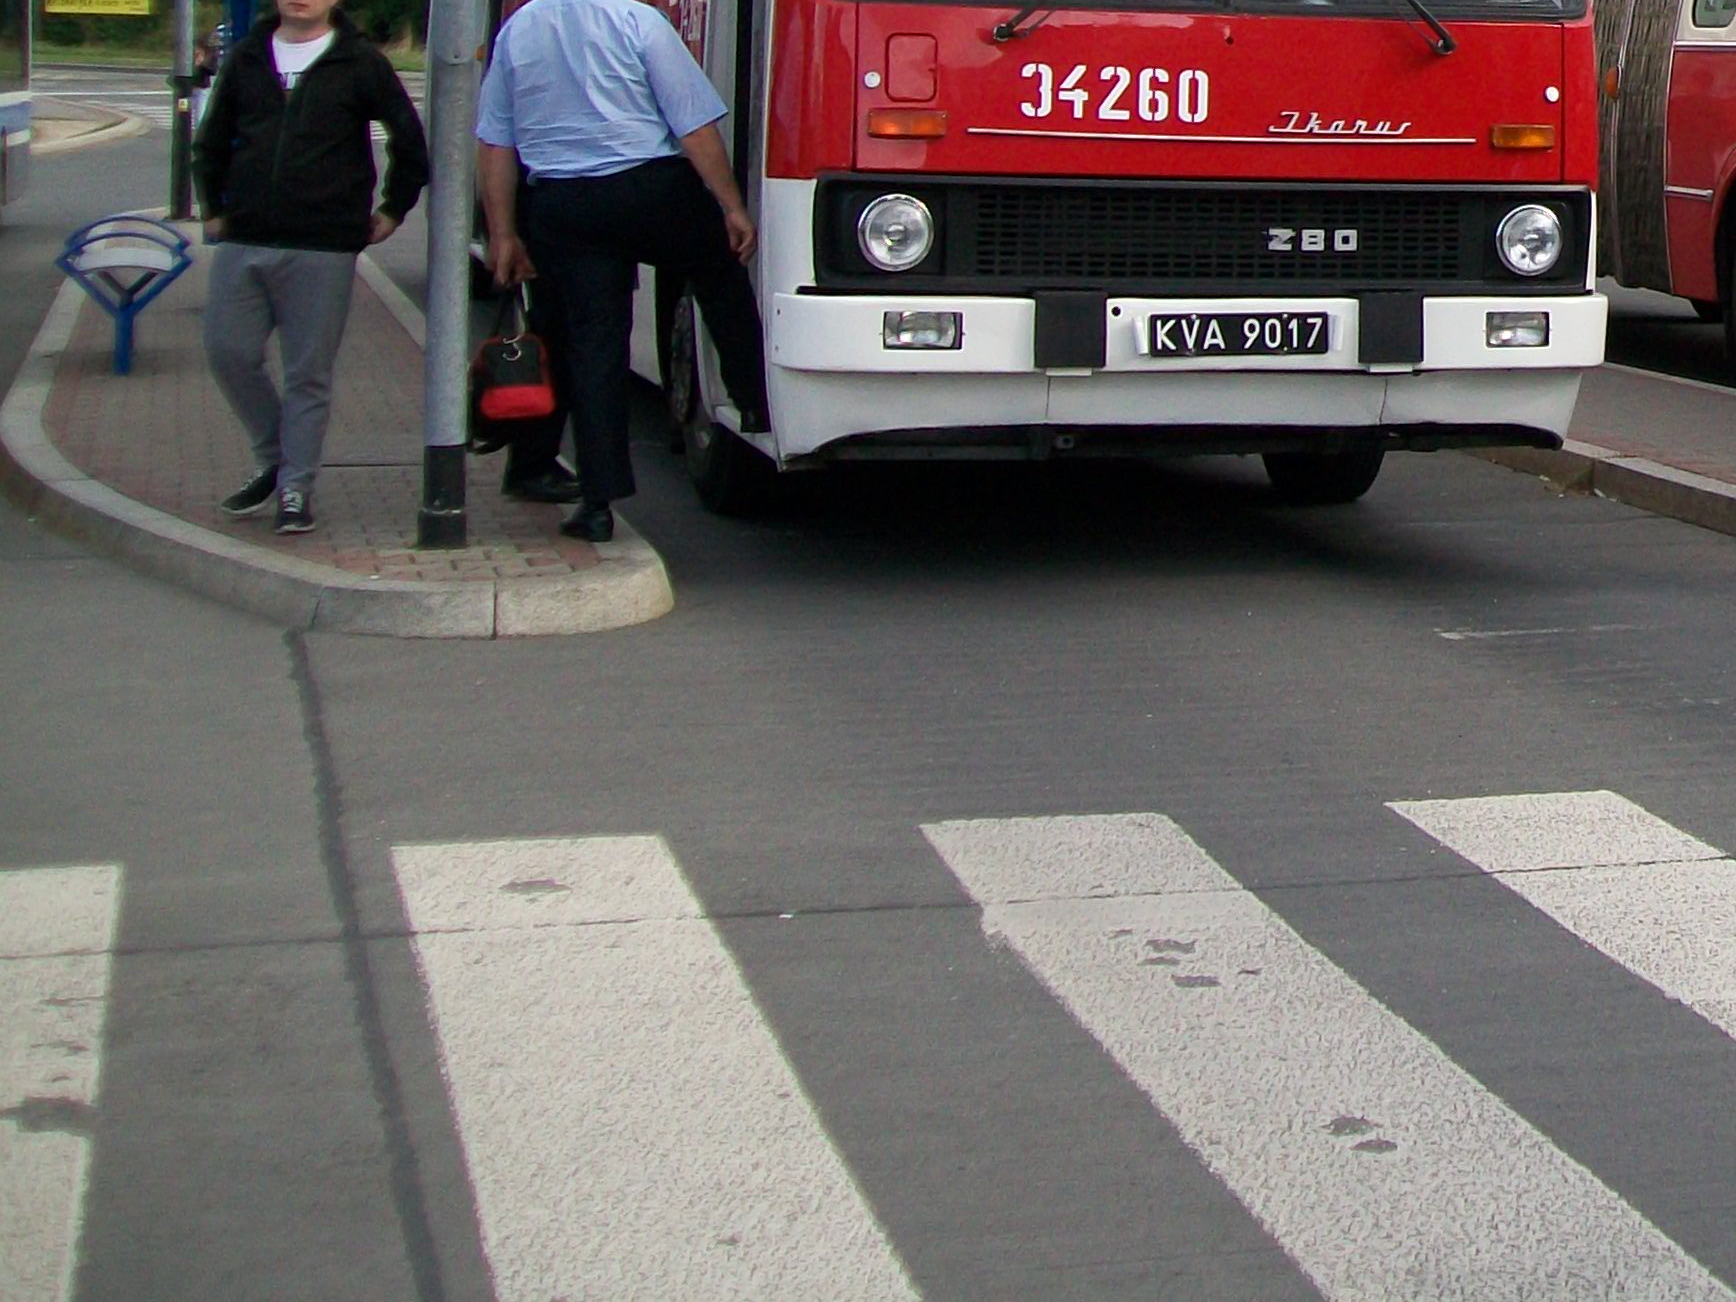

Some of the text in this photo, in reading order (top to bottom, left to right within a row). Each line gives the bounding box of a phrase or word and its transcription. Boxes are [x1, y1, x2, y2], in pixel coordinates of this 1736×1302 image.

[1020, 62, 1209, 123] 34260
[1268, 110, 1412, 135] Ikarus
[1156, 317, 1324, 350] KVA 9017
